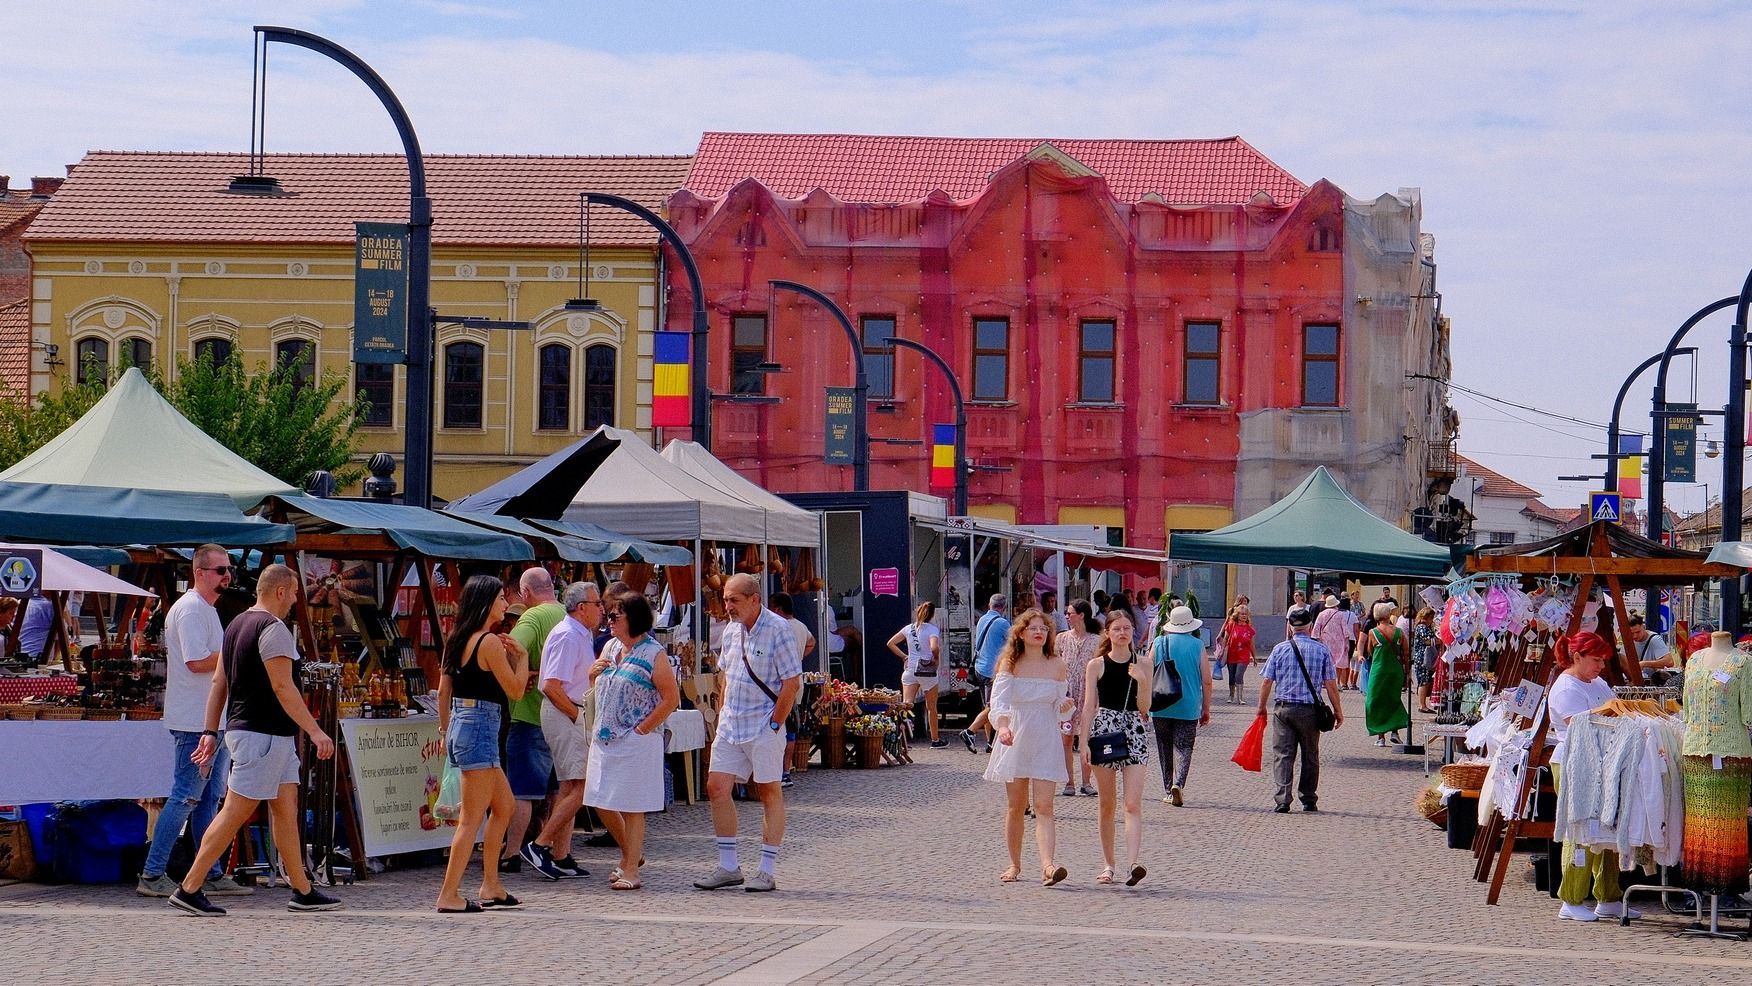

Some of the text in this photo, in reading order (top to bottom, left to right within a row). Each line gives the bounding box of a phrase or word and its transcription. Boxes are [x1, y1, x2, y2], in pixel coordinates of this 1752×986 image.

[361, 237, 402, 250] ORADEA
[361, 248, 402, 260] SUMMER
[380, 259, 402, 271] FILM
[370, 298, 391, 307] AUGUST
[373, 307, 388, 316] 2024
[395, 732, 419, 748] BIHOR
